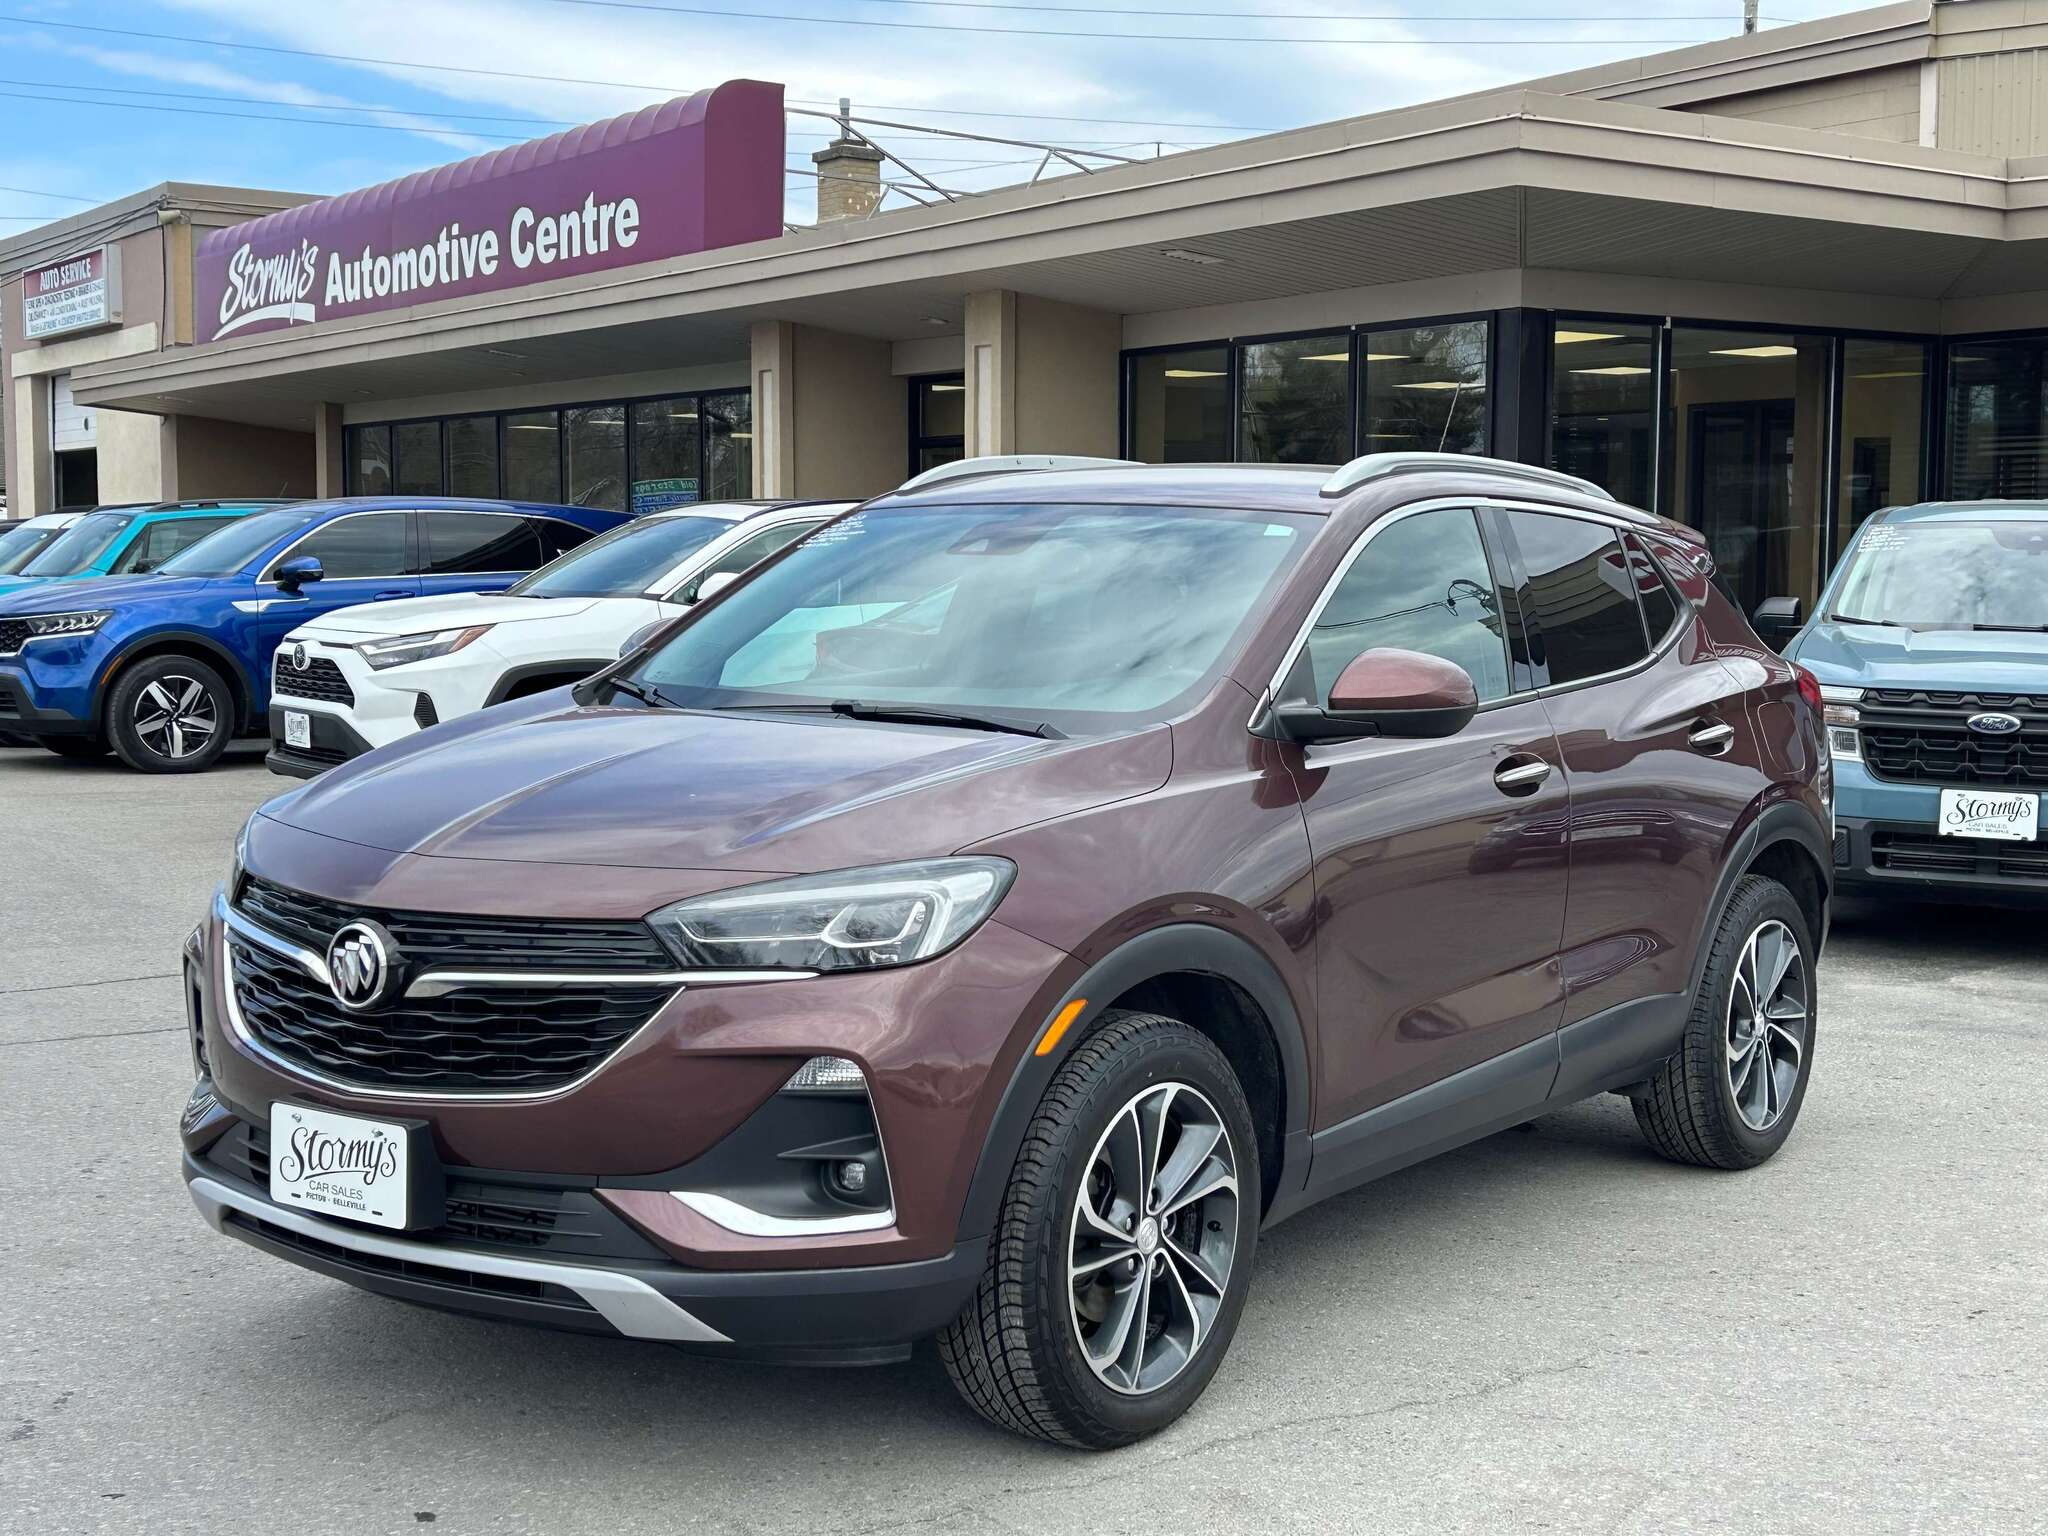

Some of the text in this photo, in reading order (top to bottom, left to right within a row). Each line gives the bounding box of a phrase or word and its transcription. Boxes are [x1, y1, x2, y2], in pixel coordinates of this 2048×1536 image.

[218, 191, 641, 325] Stormy's Automotive Centre
[40, 258, 91, 291] AUTO SERVICE
[1980, 717, 2008, 730] Ford
[1946, 797, 2032, 825] Stormy's
[280, 1127, 397, 1185] Stormy's
[308, 1179, 363, 1201] CAR SALES
[333, 1197, 367, 1211] BELLEVILLE
